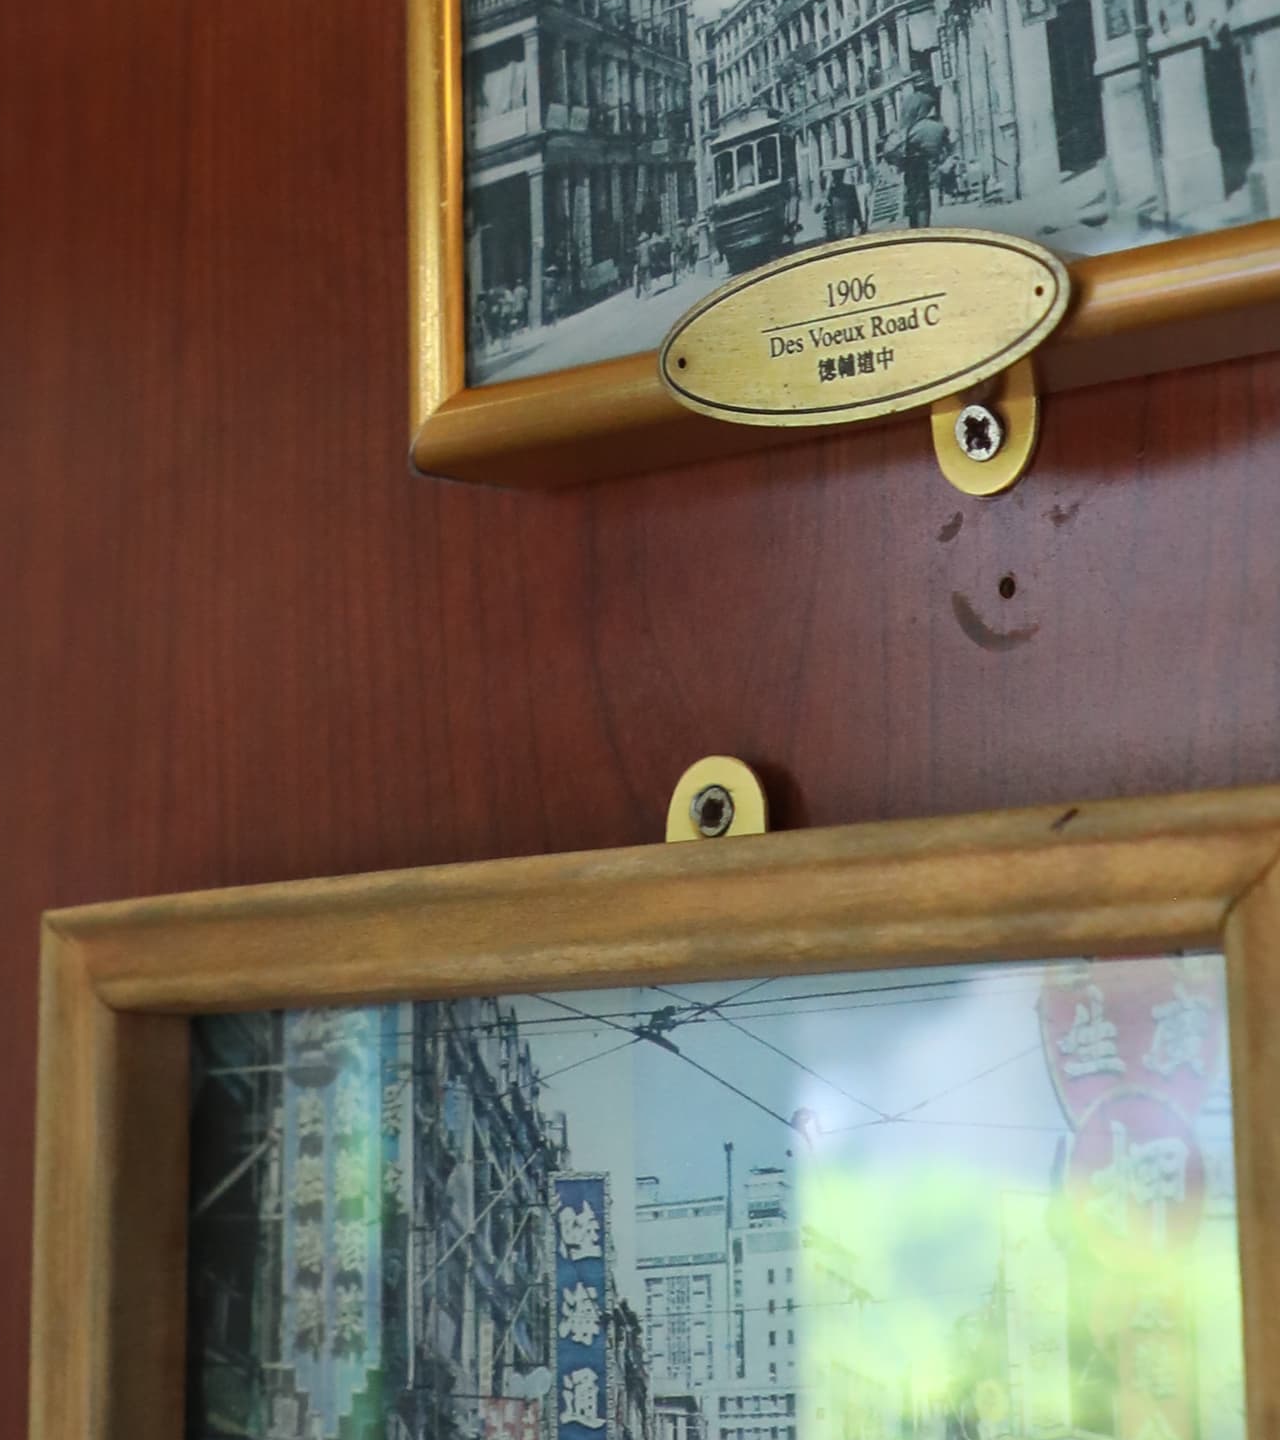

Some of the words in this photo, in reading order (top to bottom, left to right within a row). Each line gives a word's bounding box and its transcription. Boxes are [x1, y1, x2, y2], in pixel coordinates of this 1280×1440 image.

[826, 273, 877, 309] 1906
[770, 335, 804, 358] Des
[808, 323, 866, 349] Voeux
[870, 307, 920, 338] Road
[923, 303, 941, 327] C
